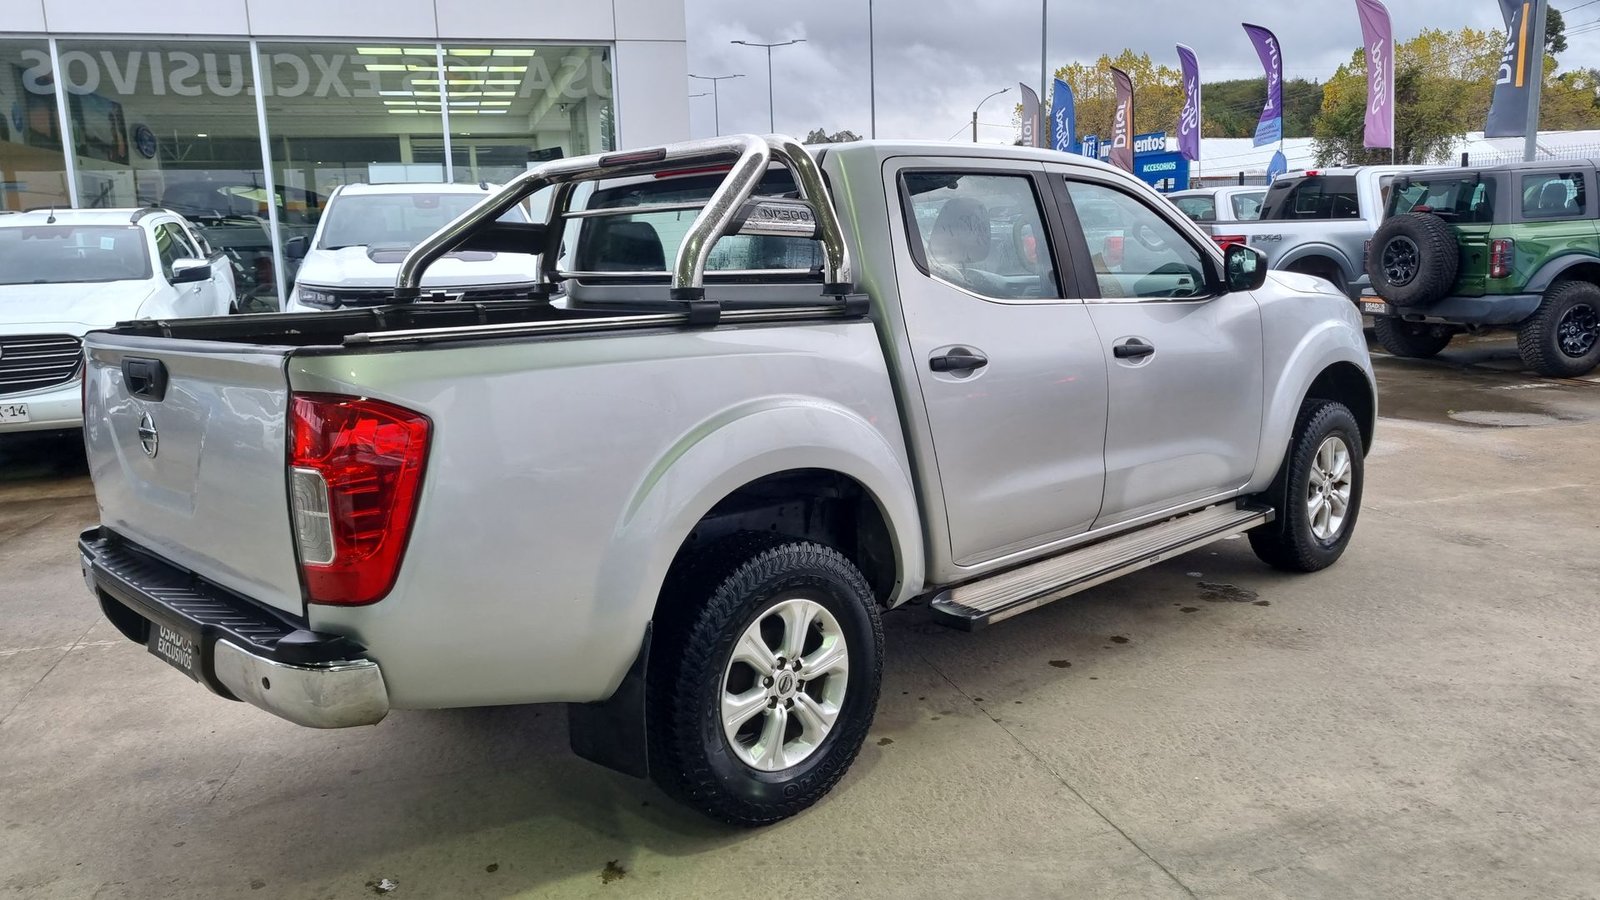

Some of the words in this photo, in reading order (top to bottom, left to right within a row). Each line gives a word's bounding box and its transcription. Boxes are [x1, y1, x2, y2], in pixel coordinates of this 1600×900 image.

[1143, 161, 1176, 173] ACCESORIOS
[762, 208, 809, 220] NP300
[1252, 234, 1282, 243] FX4
[158, 637, 192, 670] EXCLUSIVOS
